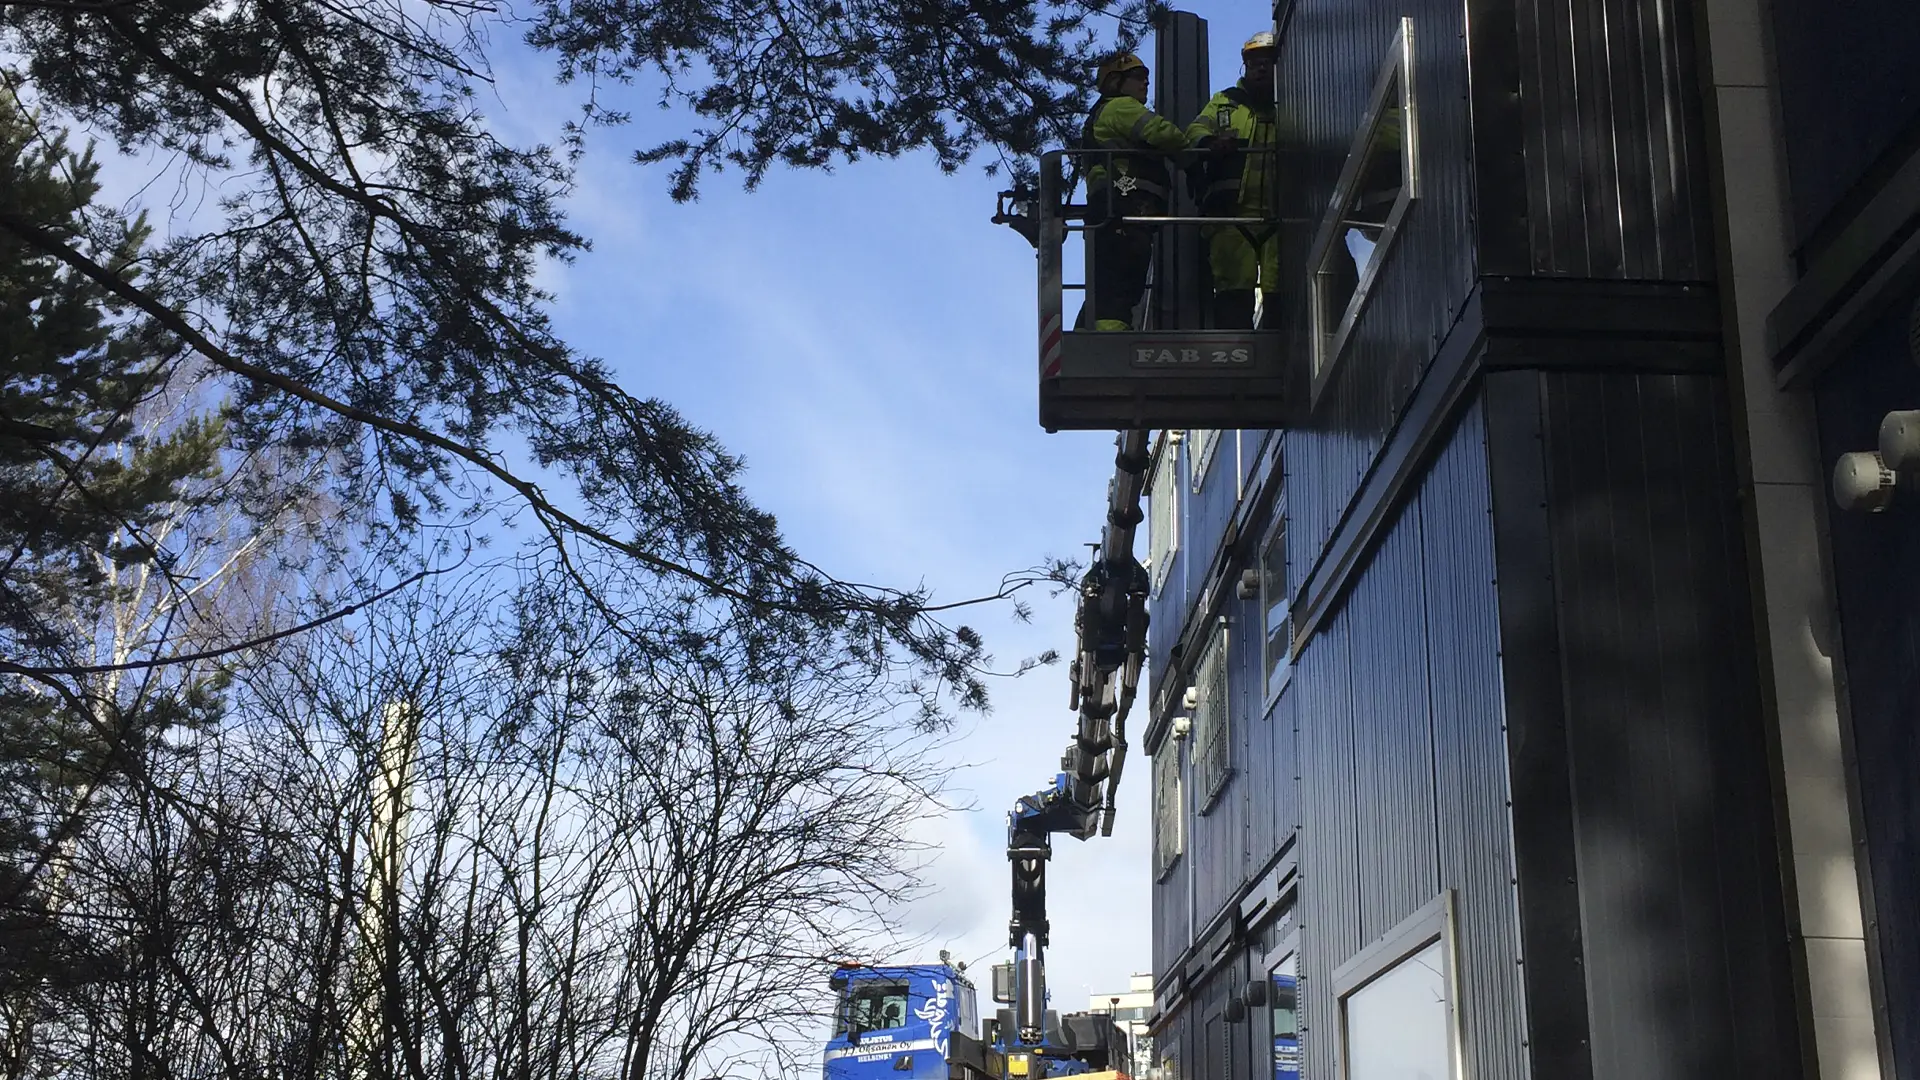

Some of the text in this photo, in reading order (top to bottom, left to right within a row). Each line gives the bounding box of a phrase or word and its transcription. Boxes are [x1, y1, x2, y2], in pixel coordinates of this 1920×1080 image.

[1136, 349, 1248, 363] FAB 2S
[859, 1043, 897, 1054] Oksanen
[899, 1041, 911, 1050] Oy
[858, 1054, 892, 1062] HELSINKI
